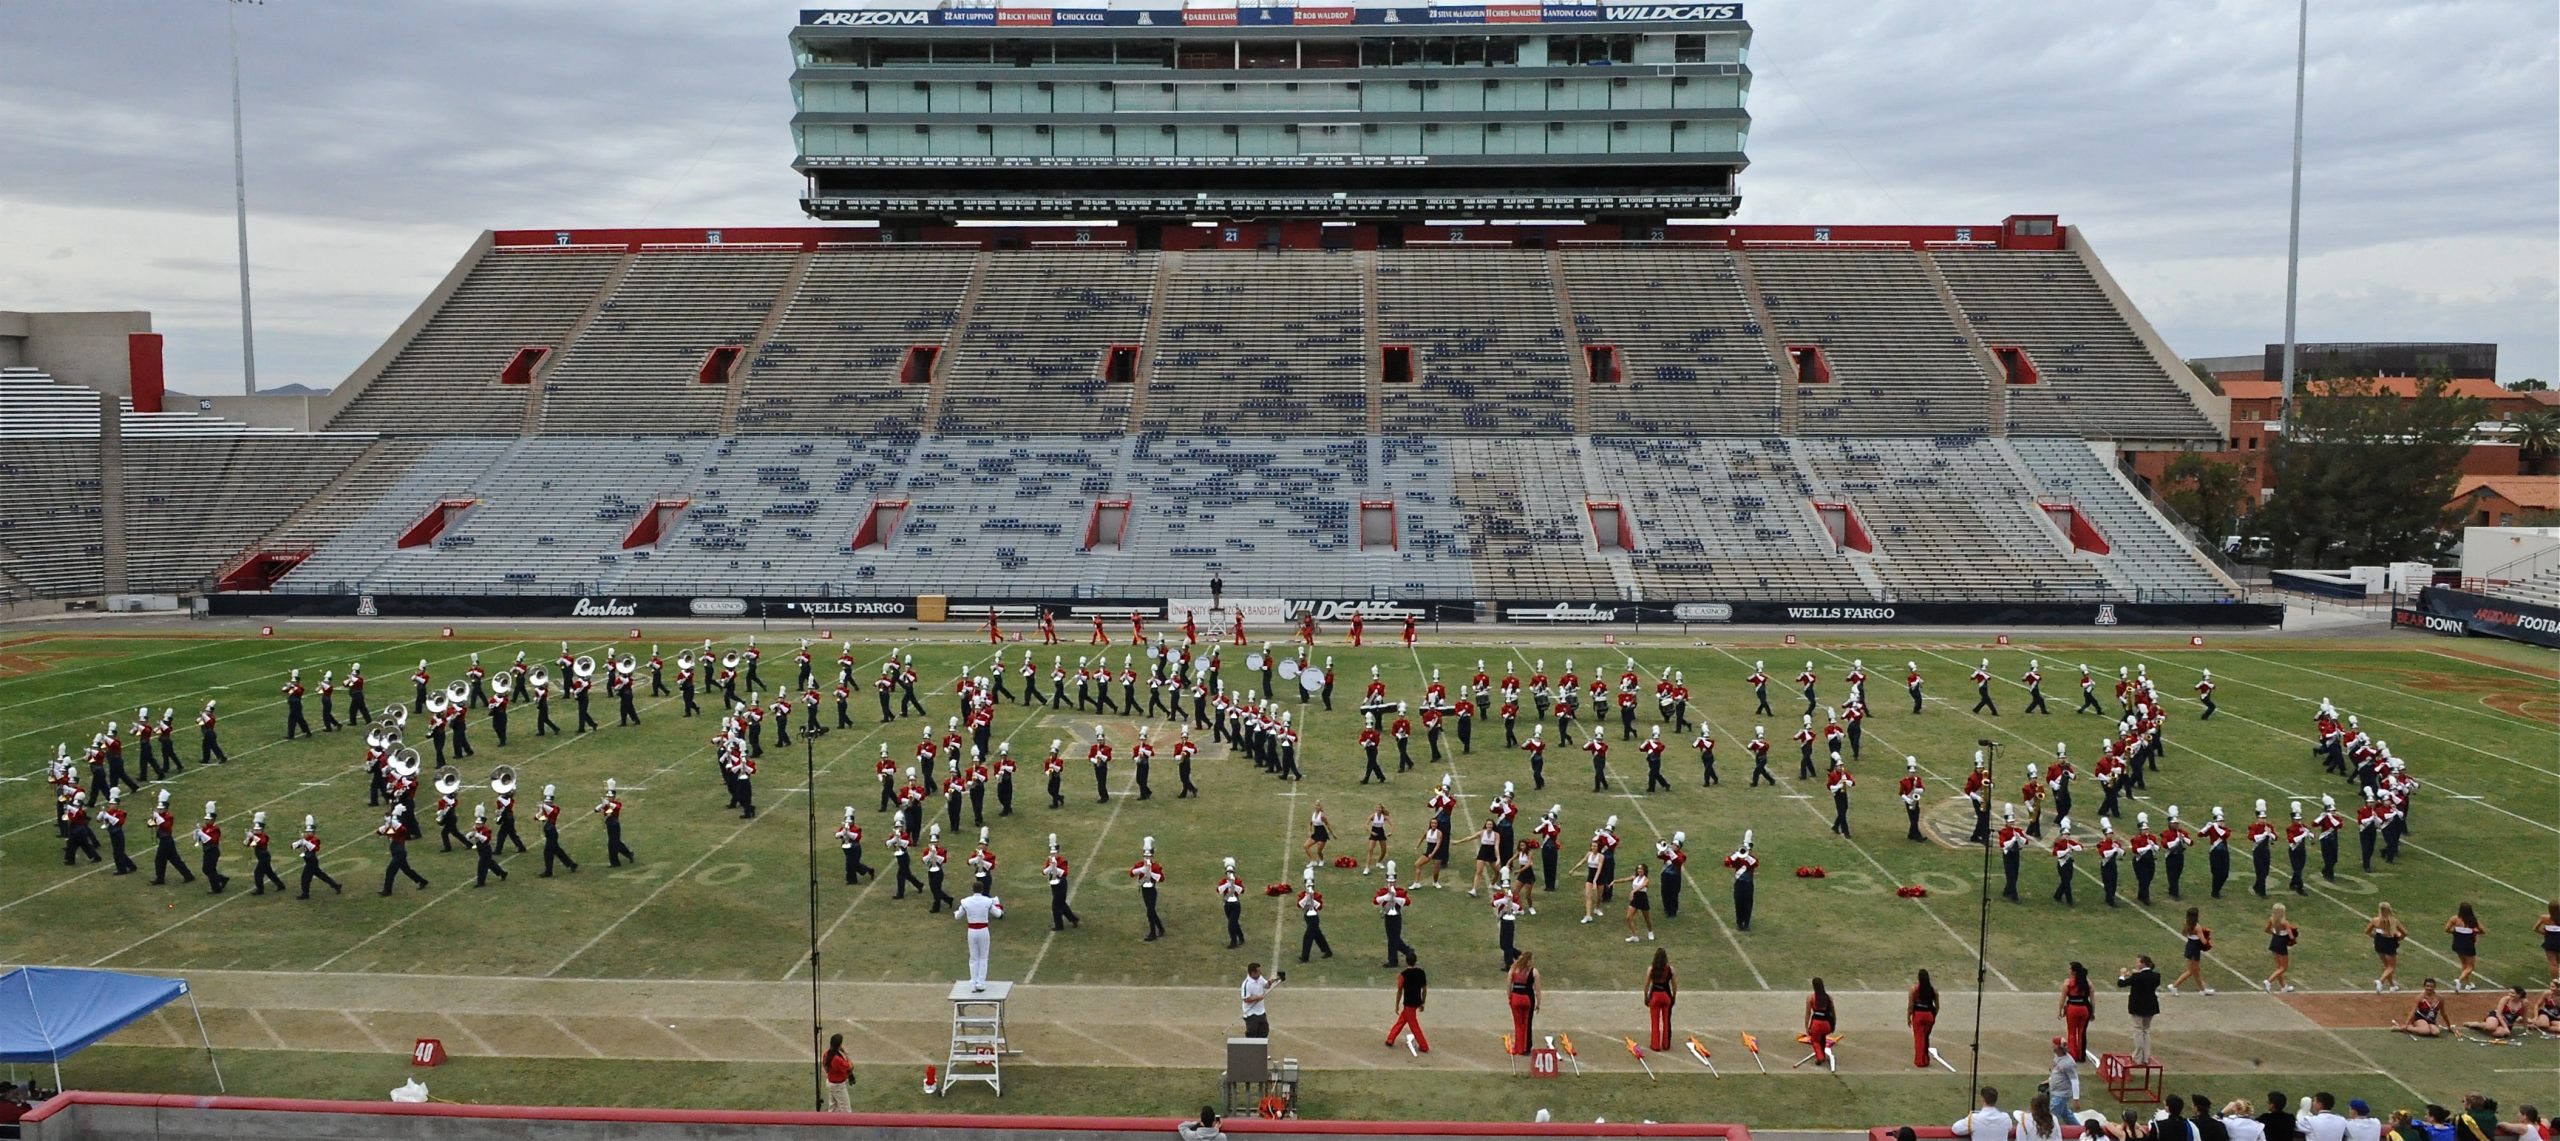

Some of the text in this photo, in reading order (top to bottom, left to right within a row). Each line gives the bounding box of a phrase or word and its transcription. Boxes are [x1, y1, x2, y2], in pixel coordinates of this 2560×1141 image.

[944, 12, 952, 20] 22
[1006, 13, 1026, 21] RICKY
[1027, 13, 1051, 21] HUNLEY
[1438, 10, 1452, 18] STEVE
[1511, 9, 1541, 17] McALISTER
[1548, 9, 1574, 17] ANTOINE
[1575, 9, 1597, 17] CASON
[1606, 6, 1735, 21] WILDCATS
[812, 11, 929, 25] ARIZONA
[558, 236, 568, 245] 17
[708, 235, 720, 244] 18
[1076, 233, 1089, 242] 20
[1226, 232, 1237, 241] 21
[1450, 233, 1463, 241] 22
[1651, 232, 1664, 241] 23
[1815, 233, 1829, 241] 24
[1957, 233, 1970, 241] 25
[200, 400, 211, 409] 16
[572, 598, 637, 616] Bashas'
[800, 603, 904, 613] WELLS FARGO
[1248, 605, 1266, 616] BAND
[1267, 605, 1281, 616] DAY
[1284, 600, 1398, 620] WILDCATS
[1788, 607, 1895, 619] WELLS FARGO
[2474, 607, 2518, 626] ARIZONA
[2396, 611, 2463, 634] BEAR DOWN
[415, 1042, 434, 1062] 40
[1534, 1053, 1553, 1073] 40
